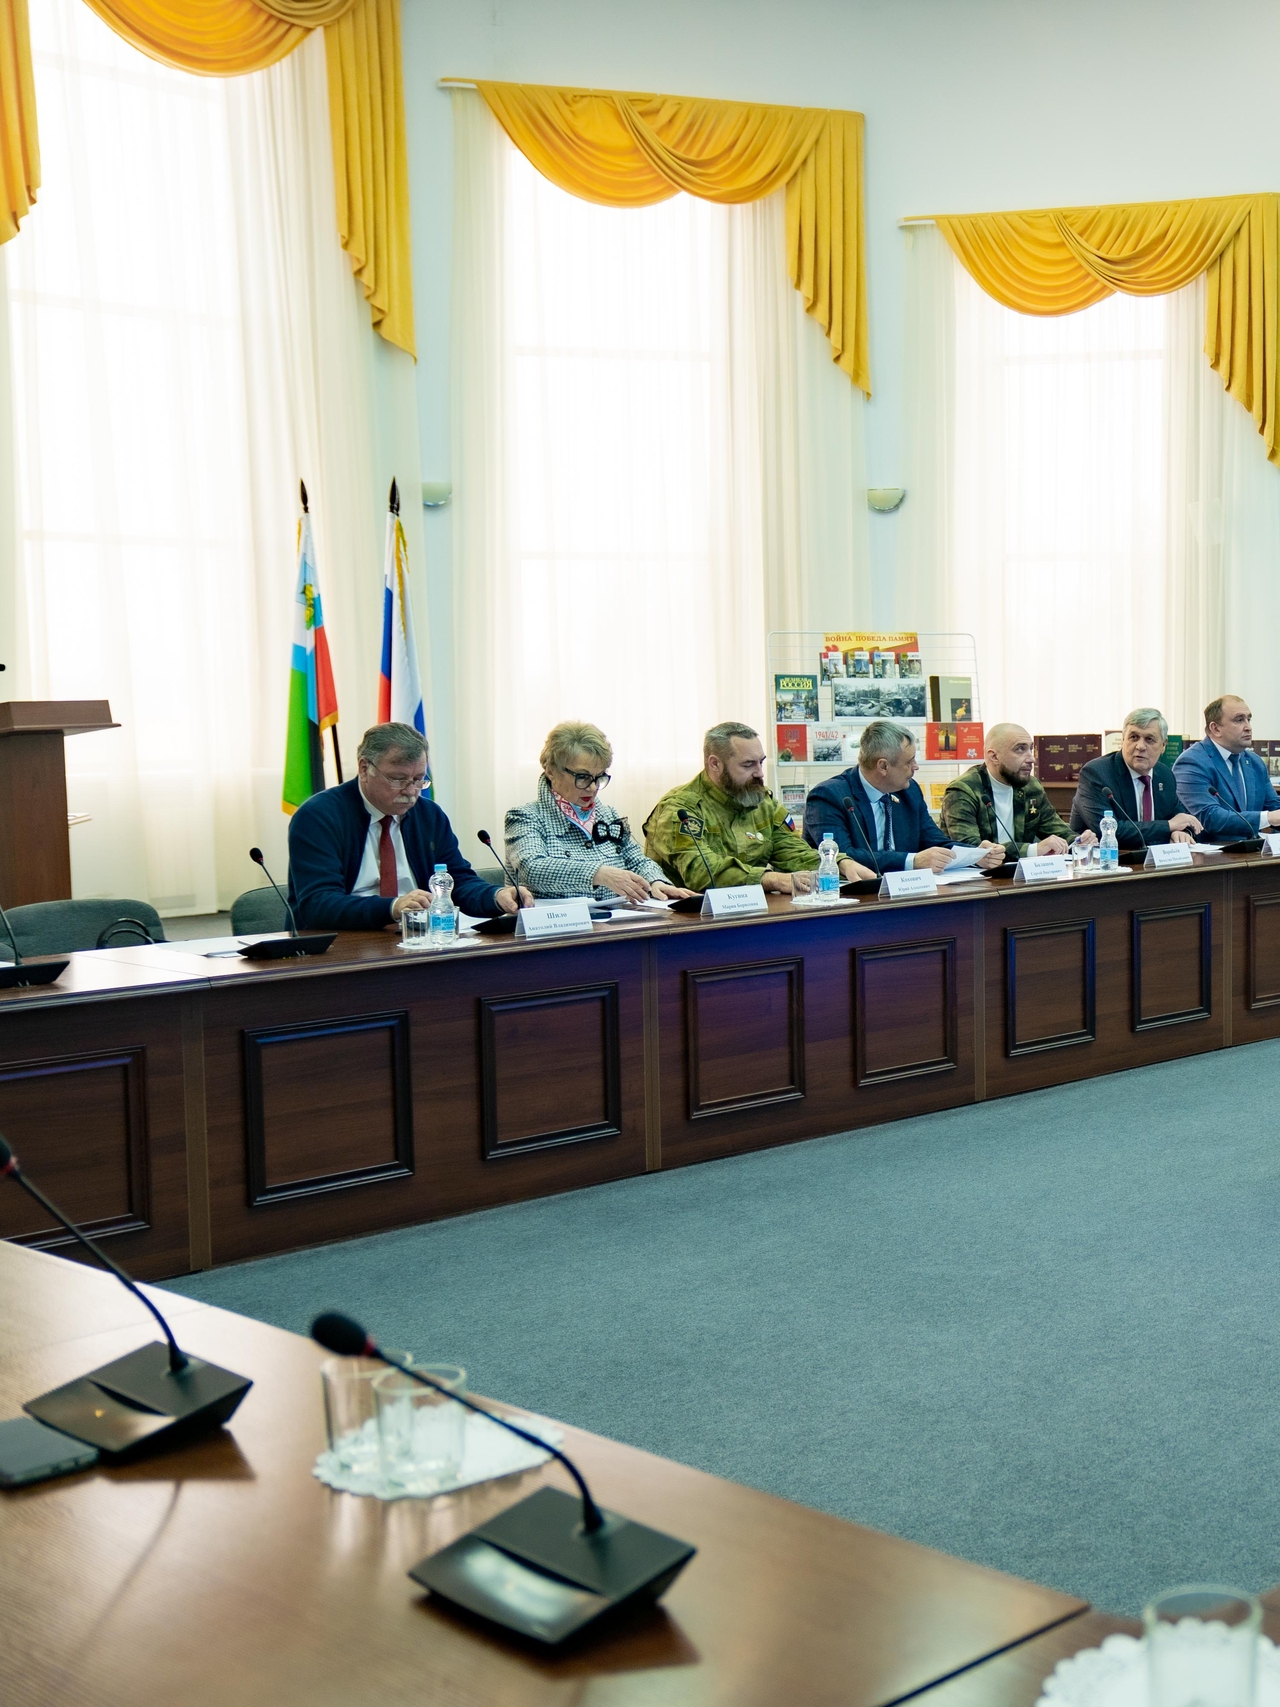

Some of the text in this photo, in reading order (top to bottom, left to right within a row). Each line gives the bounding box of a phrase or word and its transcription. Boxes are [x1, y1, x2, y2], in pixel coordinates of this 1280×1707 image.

[780, 680, 812, 689] РОССИЯ
[815, 730, 839, 739] 1941/42
[784, 793, 804, 801] ИСТОРИЯ
[553, 921, 590, 929] Владимирович
